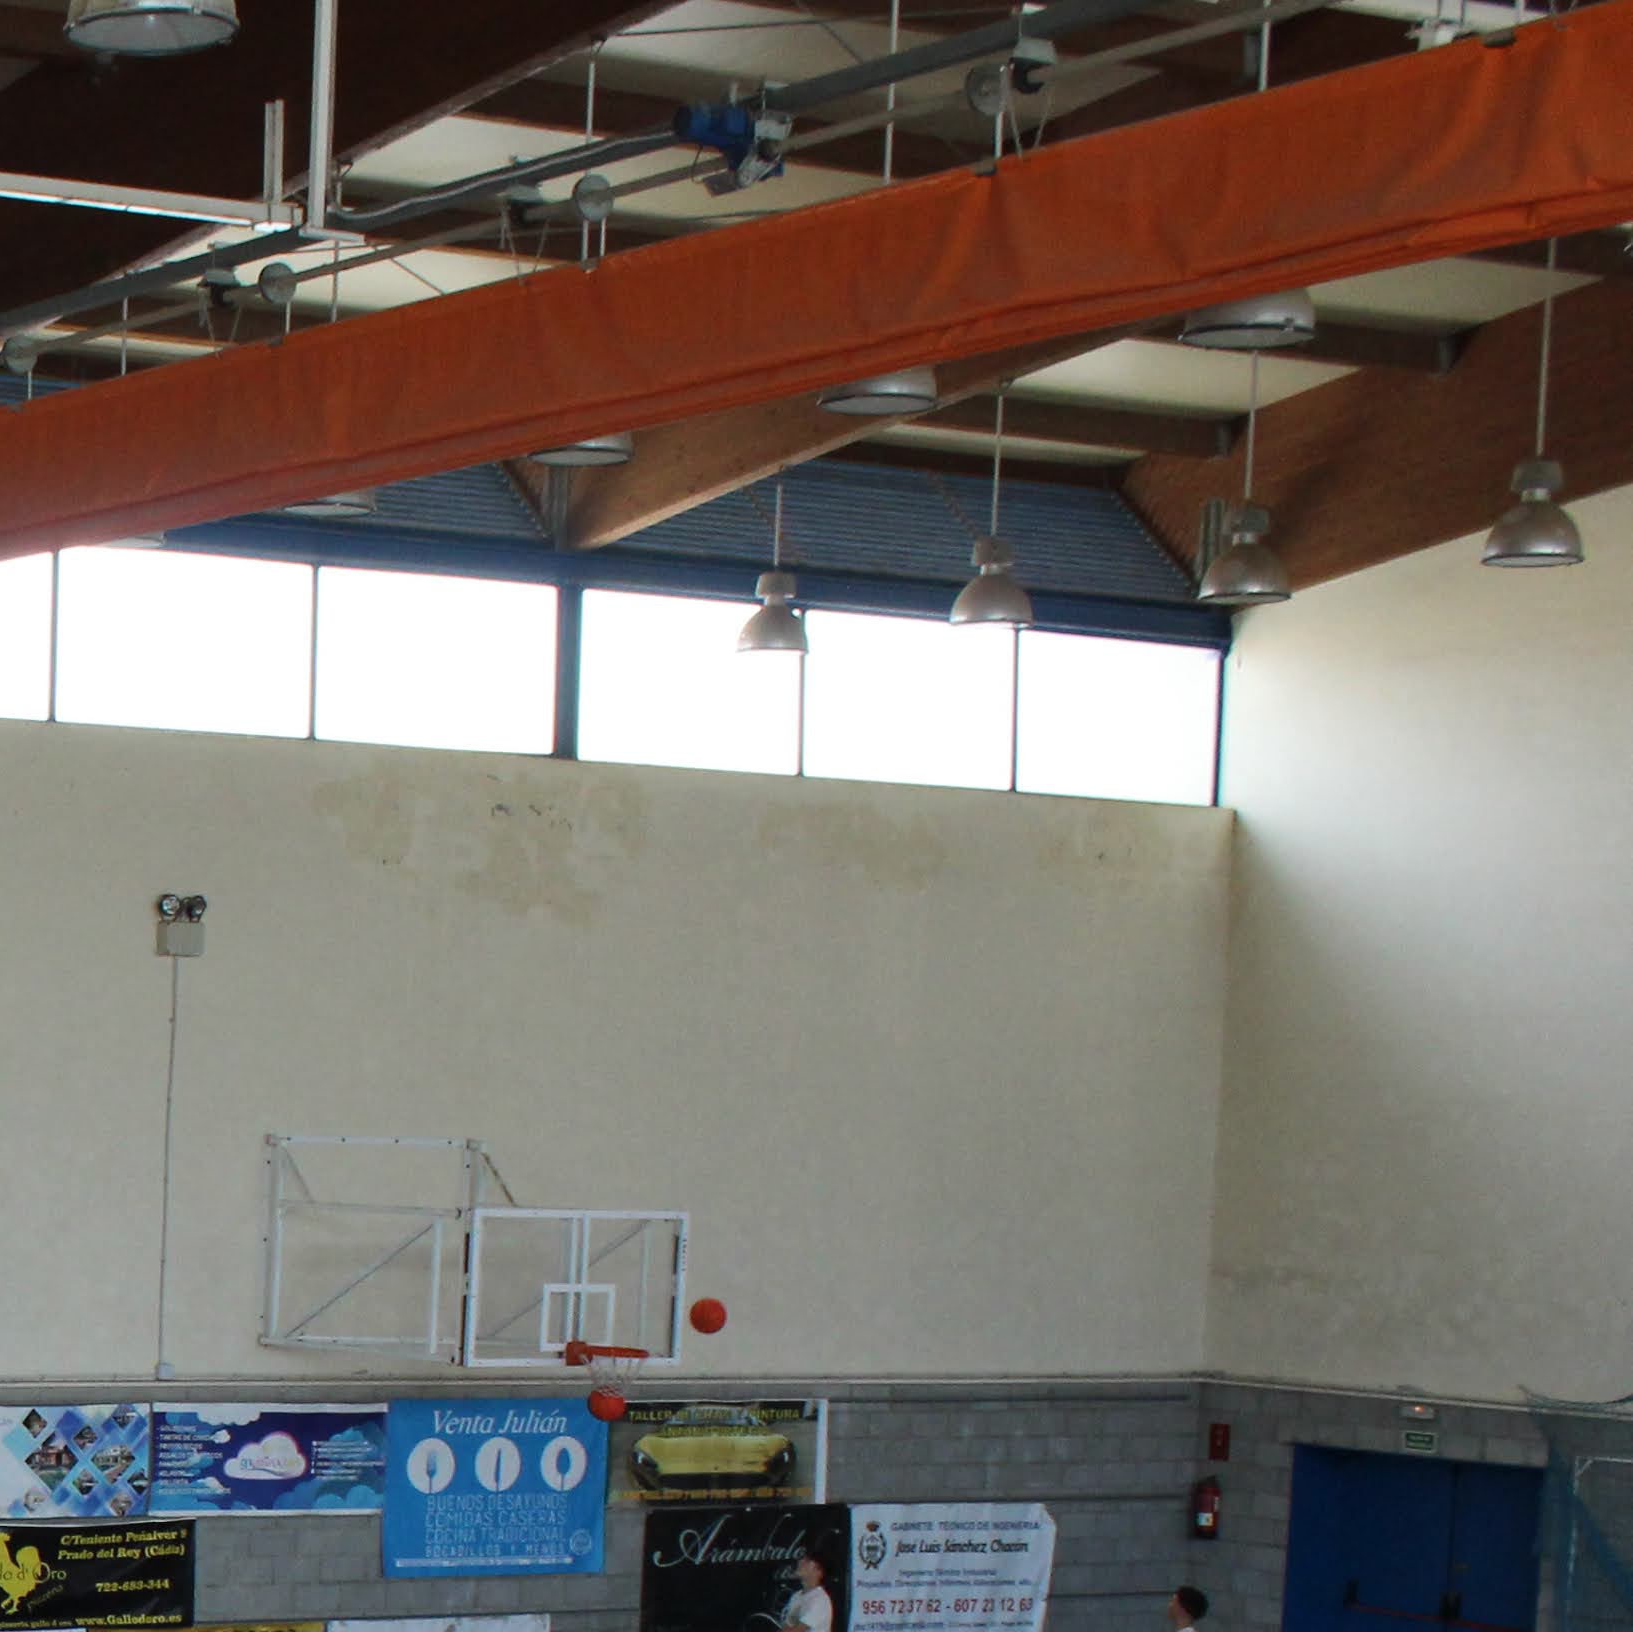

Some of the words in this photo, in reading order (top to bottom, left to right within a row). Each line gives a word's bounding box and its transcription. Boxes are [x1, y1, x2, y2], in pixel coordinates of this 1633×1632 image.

[434, 1409, 495, 1434] Venta
[499, 1409, 567, 1434] Julián
[426, 1511, 494, 1528] COMIDAS
[499, 1510, 566, 1526] CASERAS
[426, 1527, 476, 1544] COCINA
[480, 1526, 566, 1543] TRADICIONAL
[57, 1549, 94, 1561] Prado
[97, 1548, 114, 1559] del
[117, 1547, 141, 1559] Rey
[895, 1539, 917, 1557] José
[920, 1539, 941, 1553] Luis
[944, 1539, 987, 1553] Sánchez
[991, 1538, 1029, 1553] Chacón
[33, 1561, 67, 1581] Oro
